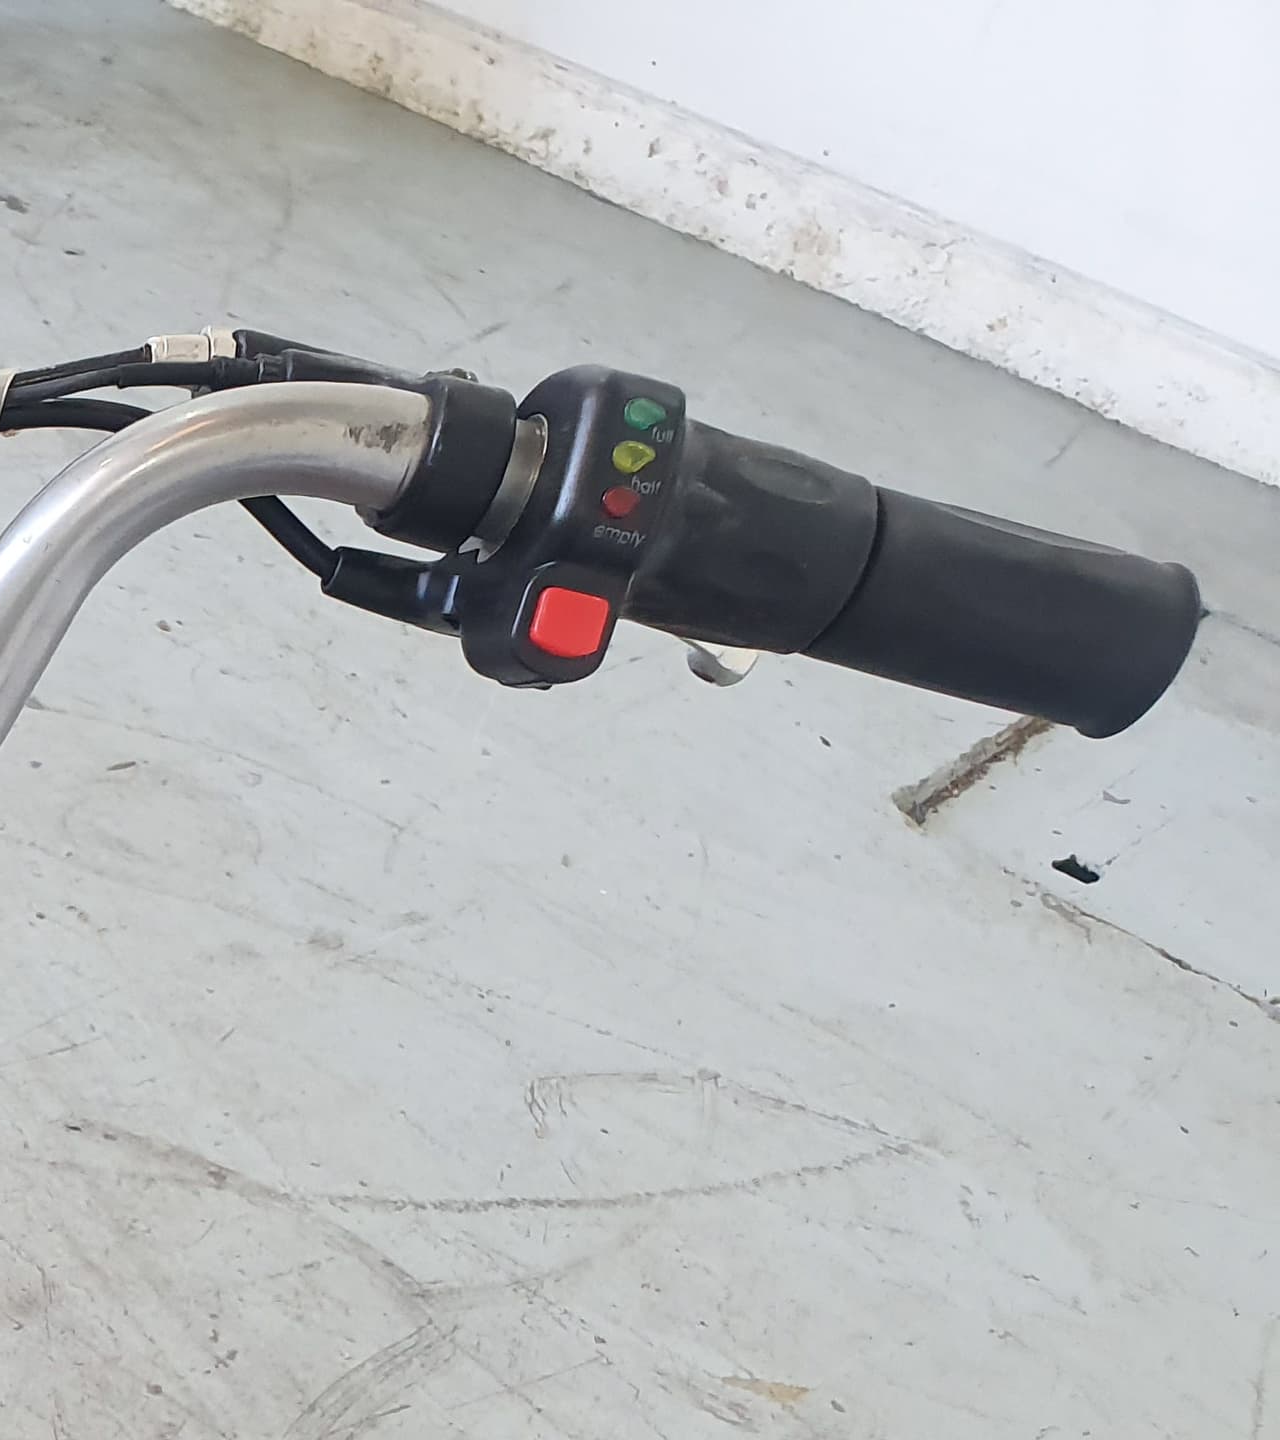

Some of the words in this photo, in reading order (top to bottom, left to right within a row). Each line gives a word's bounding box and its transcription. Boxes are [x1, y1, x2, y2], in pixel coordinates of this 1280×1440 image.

[651, 426, 675, 443] full
[631, 475, 662, 495] half
[593, 525, 646, 548] empty
